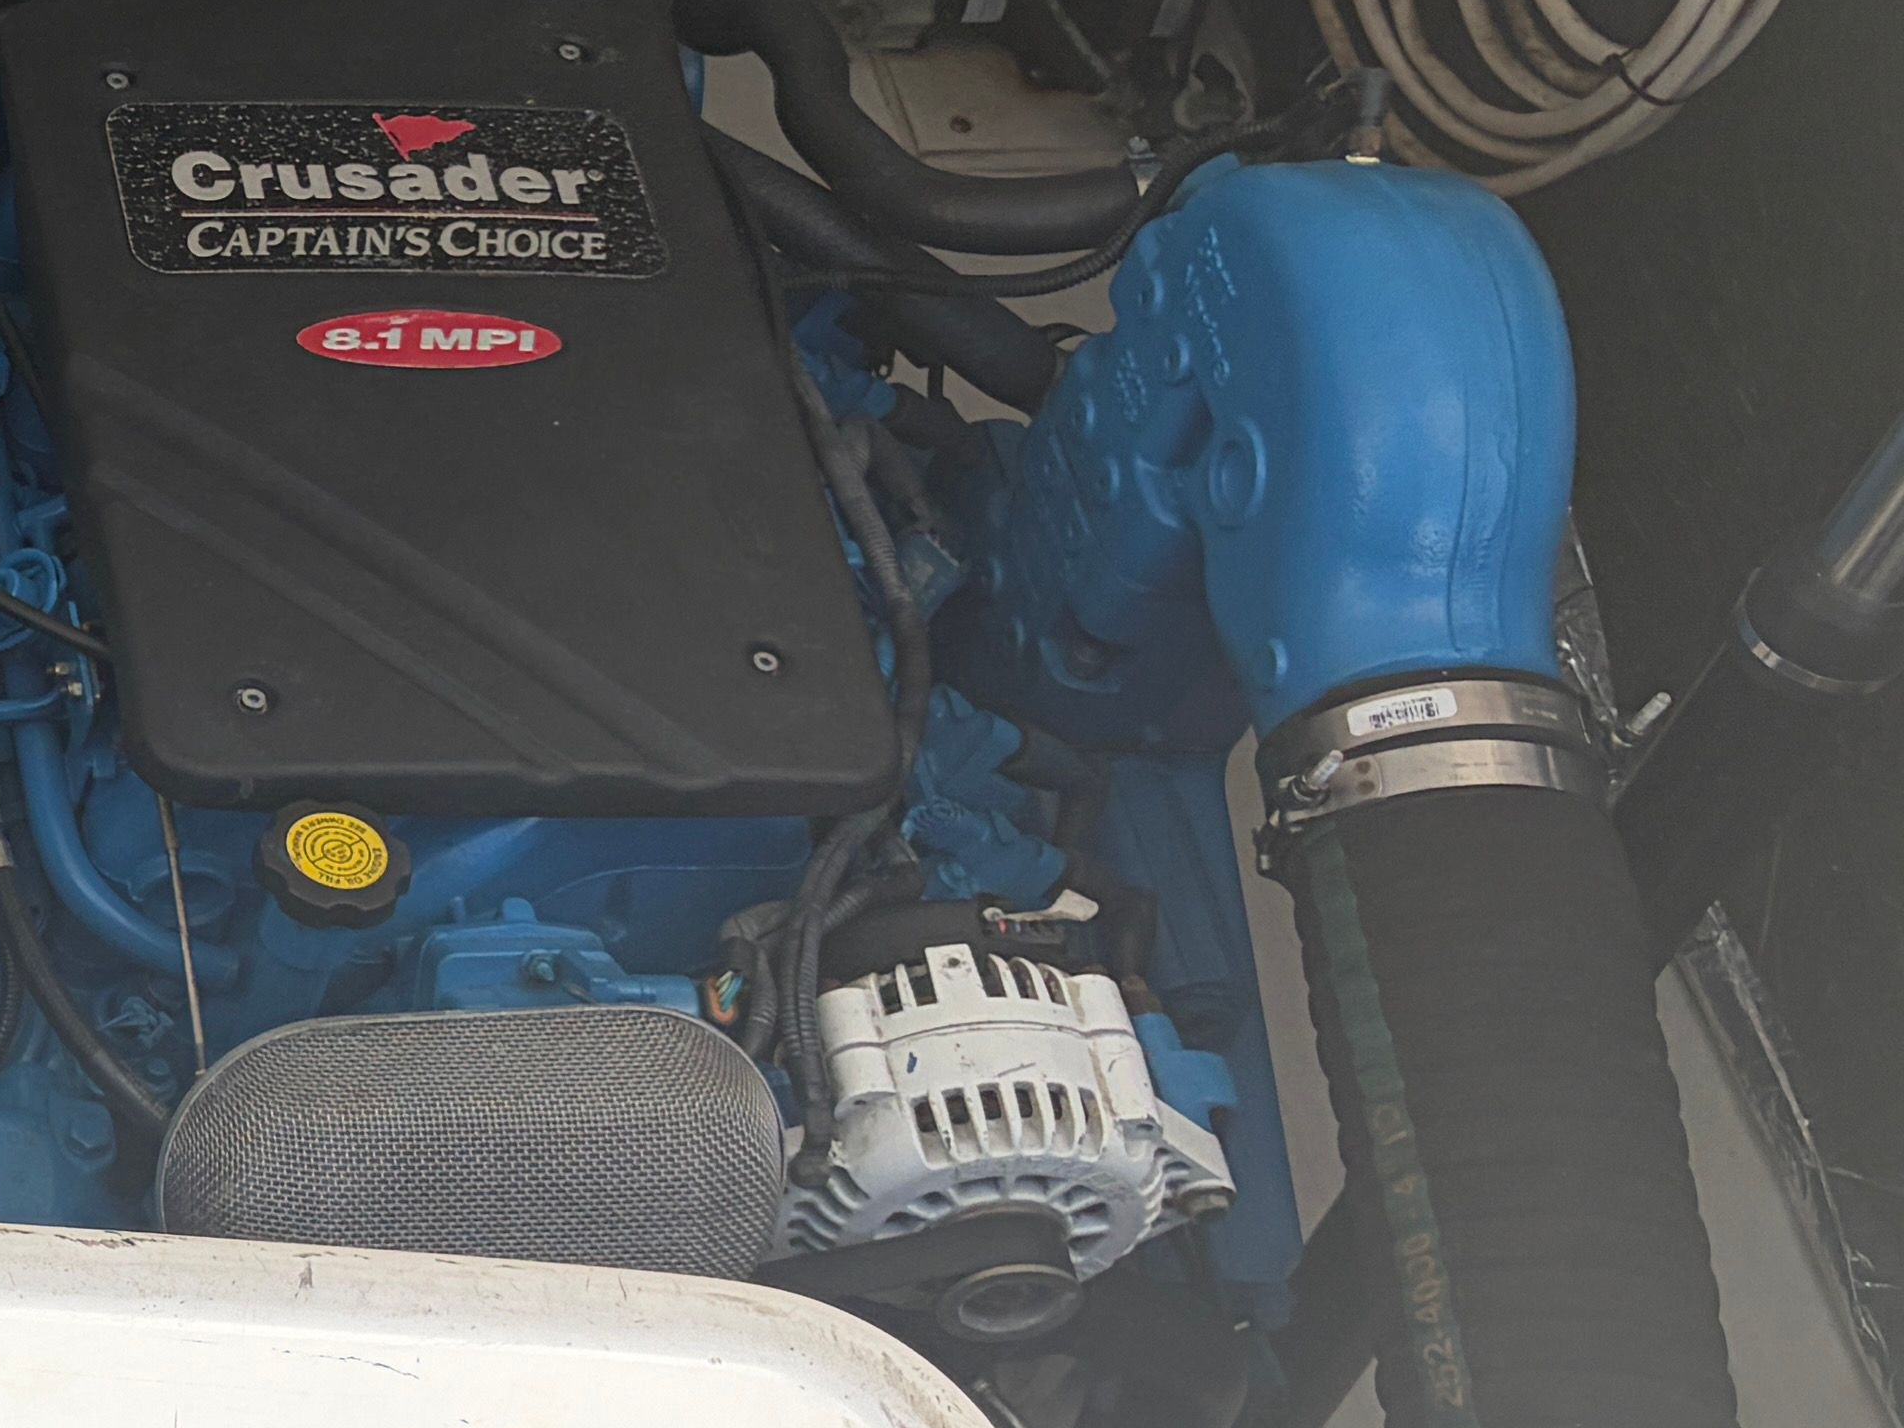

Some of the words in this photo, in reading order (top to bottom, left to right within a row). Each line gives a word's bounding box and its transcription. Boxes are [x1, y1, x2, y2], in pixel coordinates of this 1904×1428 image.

[172, 150, 592, 205] Crusader
[187, 222, 431, 258] CAPTAIN'S
[439, 222, 606, 261] CHOICE
[322, 327, 403, 351] 8.1
[419, 327, 536, 353] MPI
